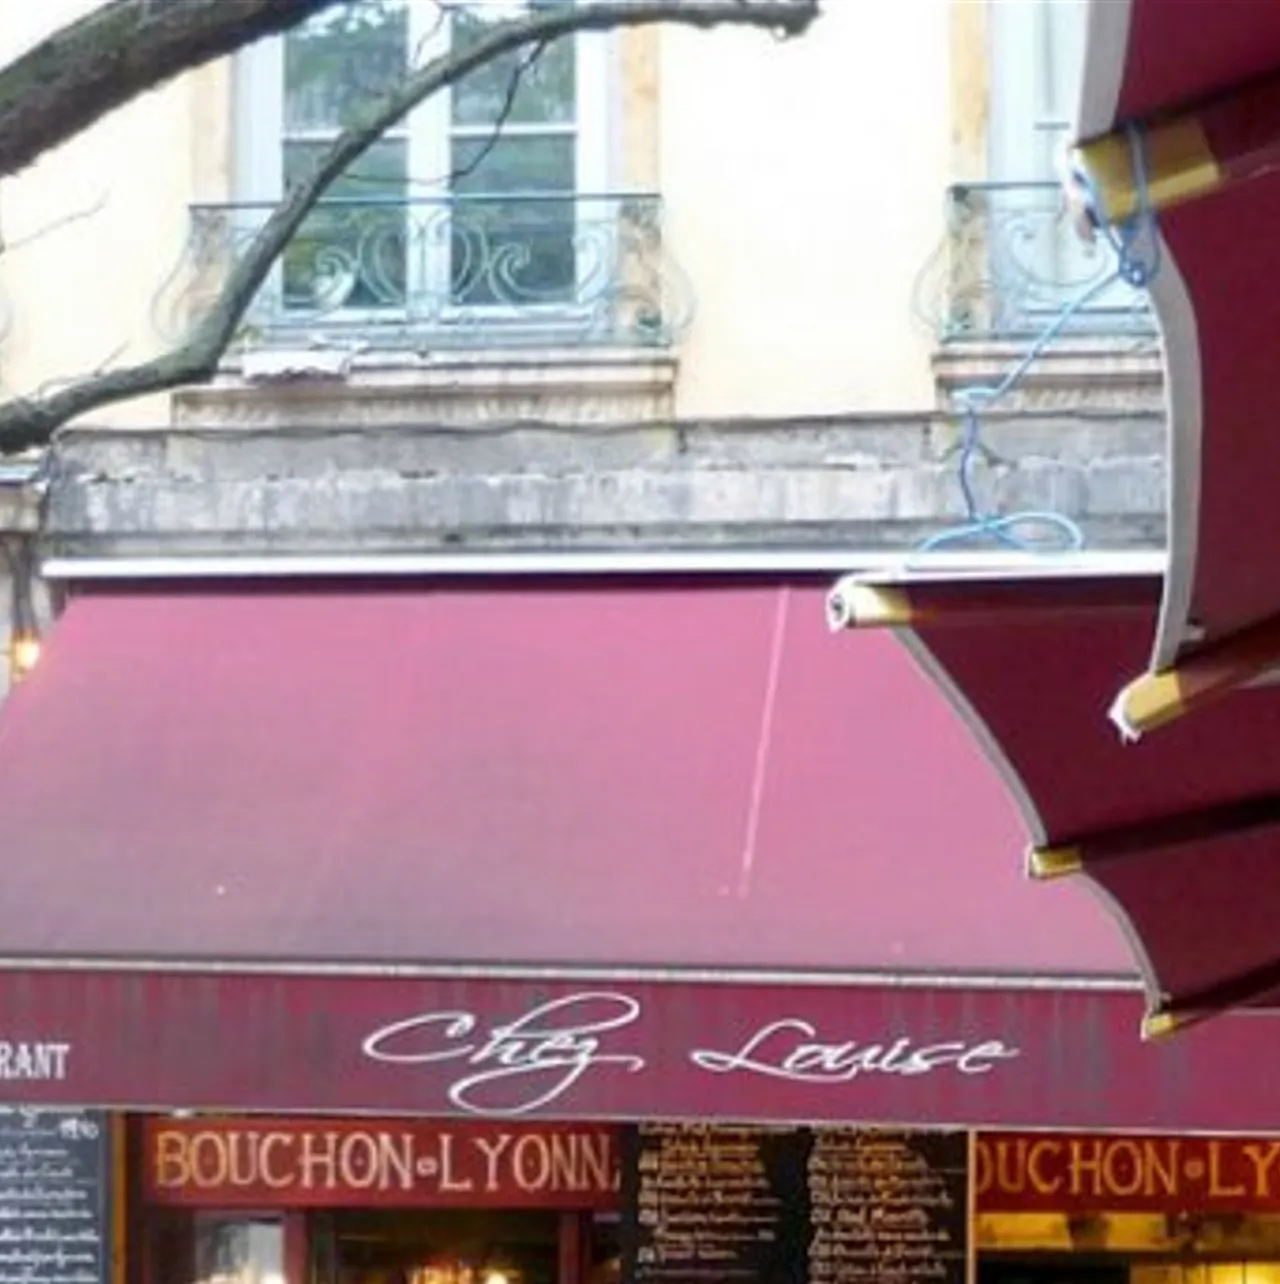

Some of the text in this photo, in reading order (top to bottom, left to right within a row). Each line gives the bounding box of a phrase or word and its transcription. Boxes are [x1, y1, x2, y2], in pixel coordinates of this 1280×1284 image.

[362, 991, 1020, 1114] Chez Louise
[438, 1132, 620, 1193] LYONN
